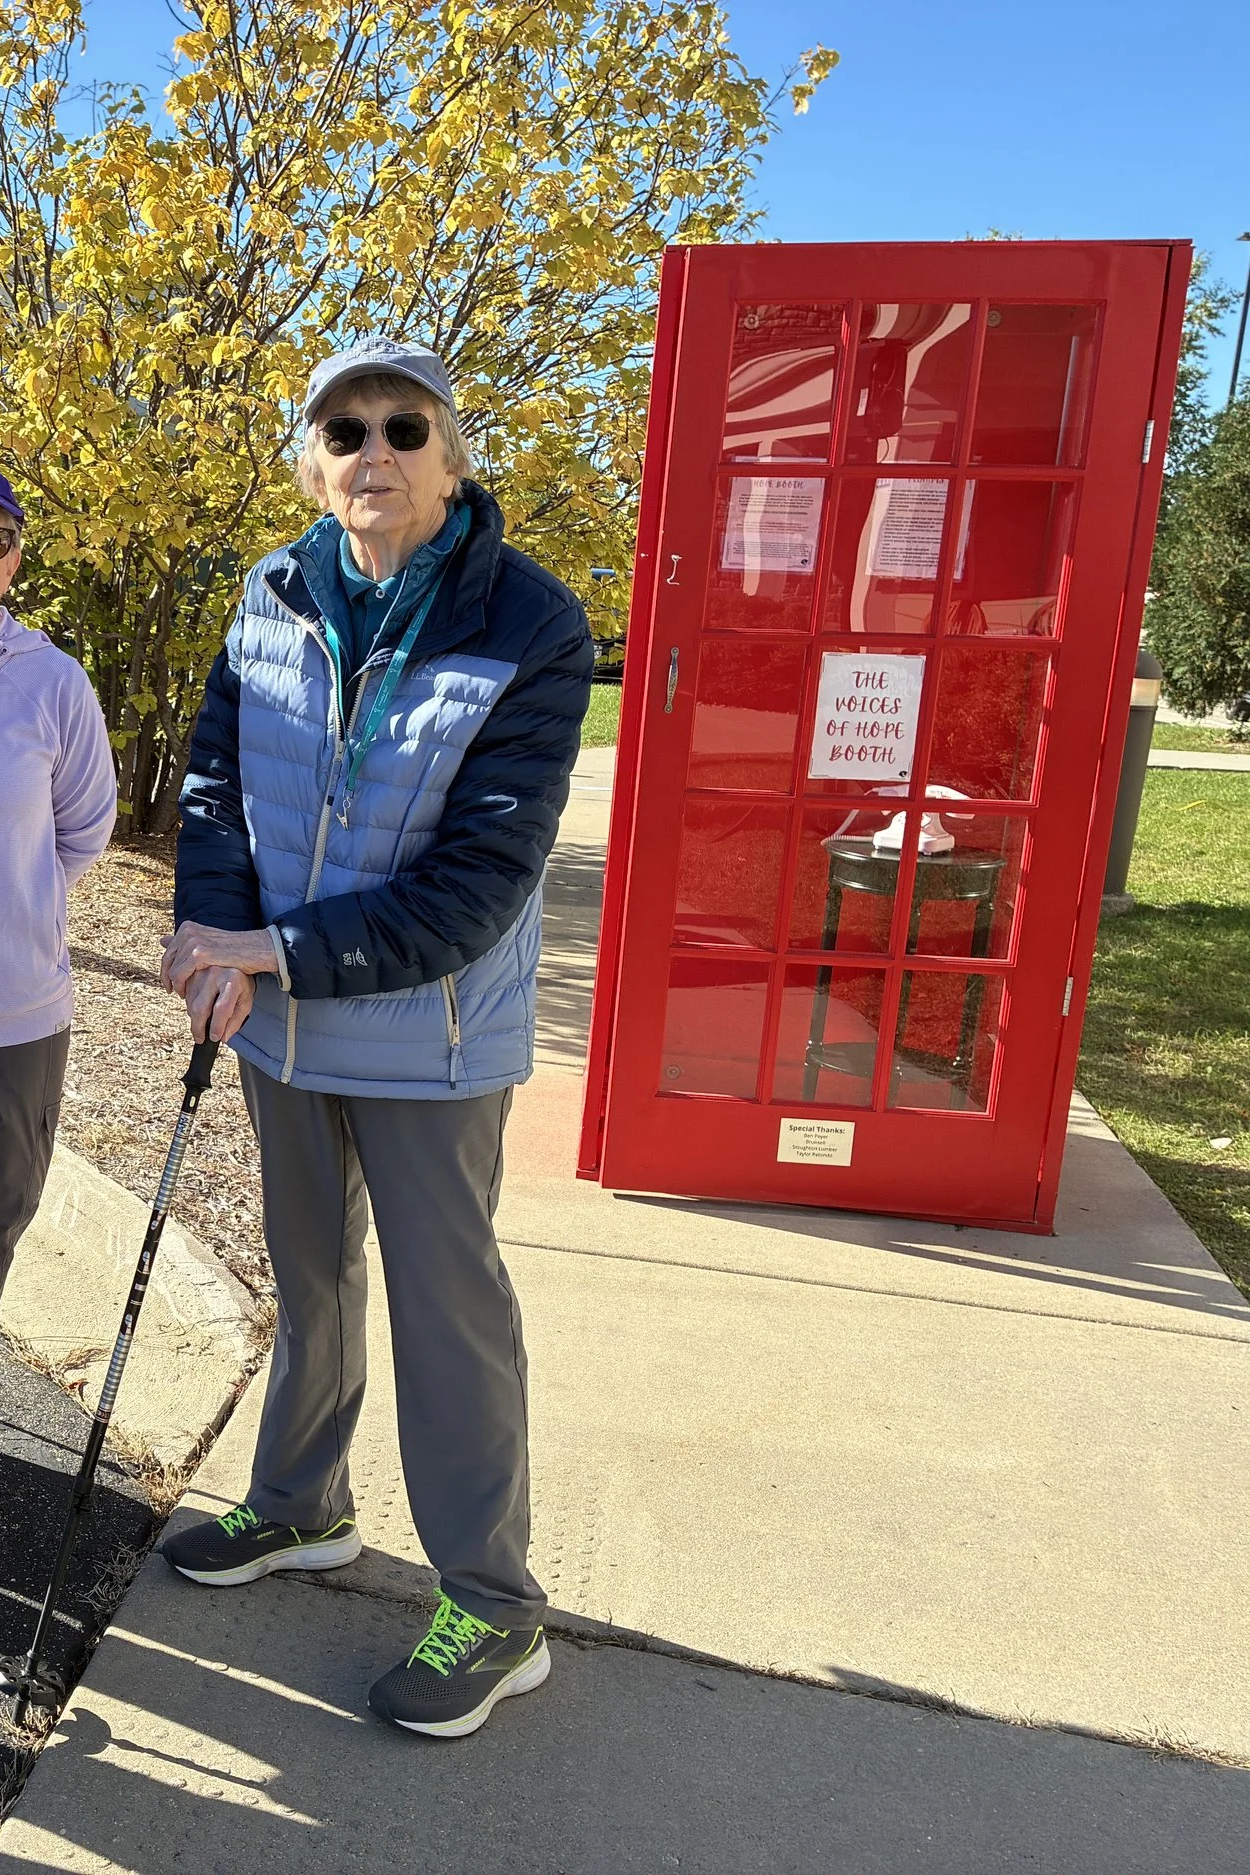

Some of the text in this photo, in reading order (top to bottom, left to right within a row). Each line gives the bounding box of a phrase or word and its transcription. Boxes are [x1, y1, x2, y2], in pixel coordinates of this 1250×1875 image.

[852, 671, 888, 690] THE
[835, 695, 902, 714] VOICES
[826, 719, 905, 739] OF HOPE
[829, 744, 896, 764] BOOTH
[789, 1124, 846, 1134] Special Thanks:
